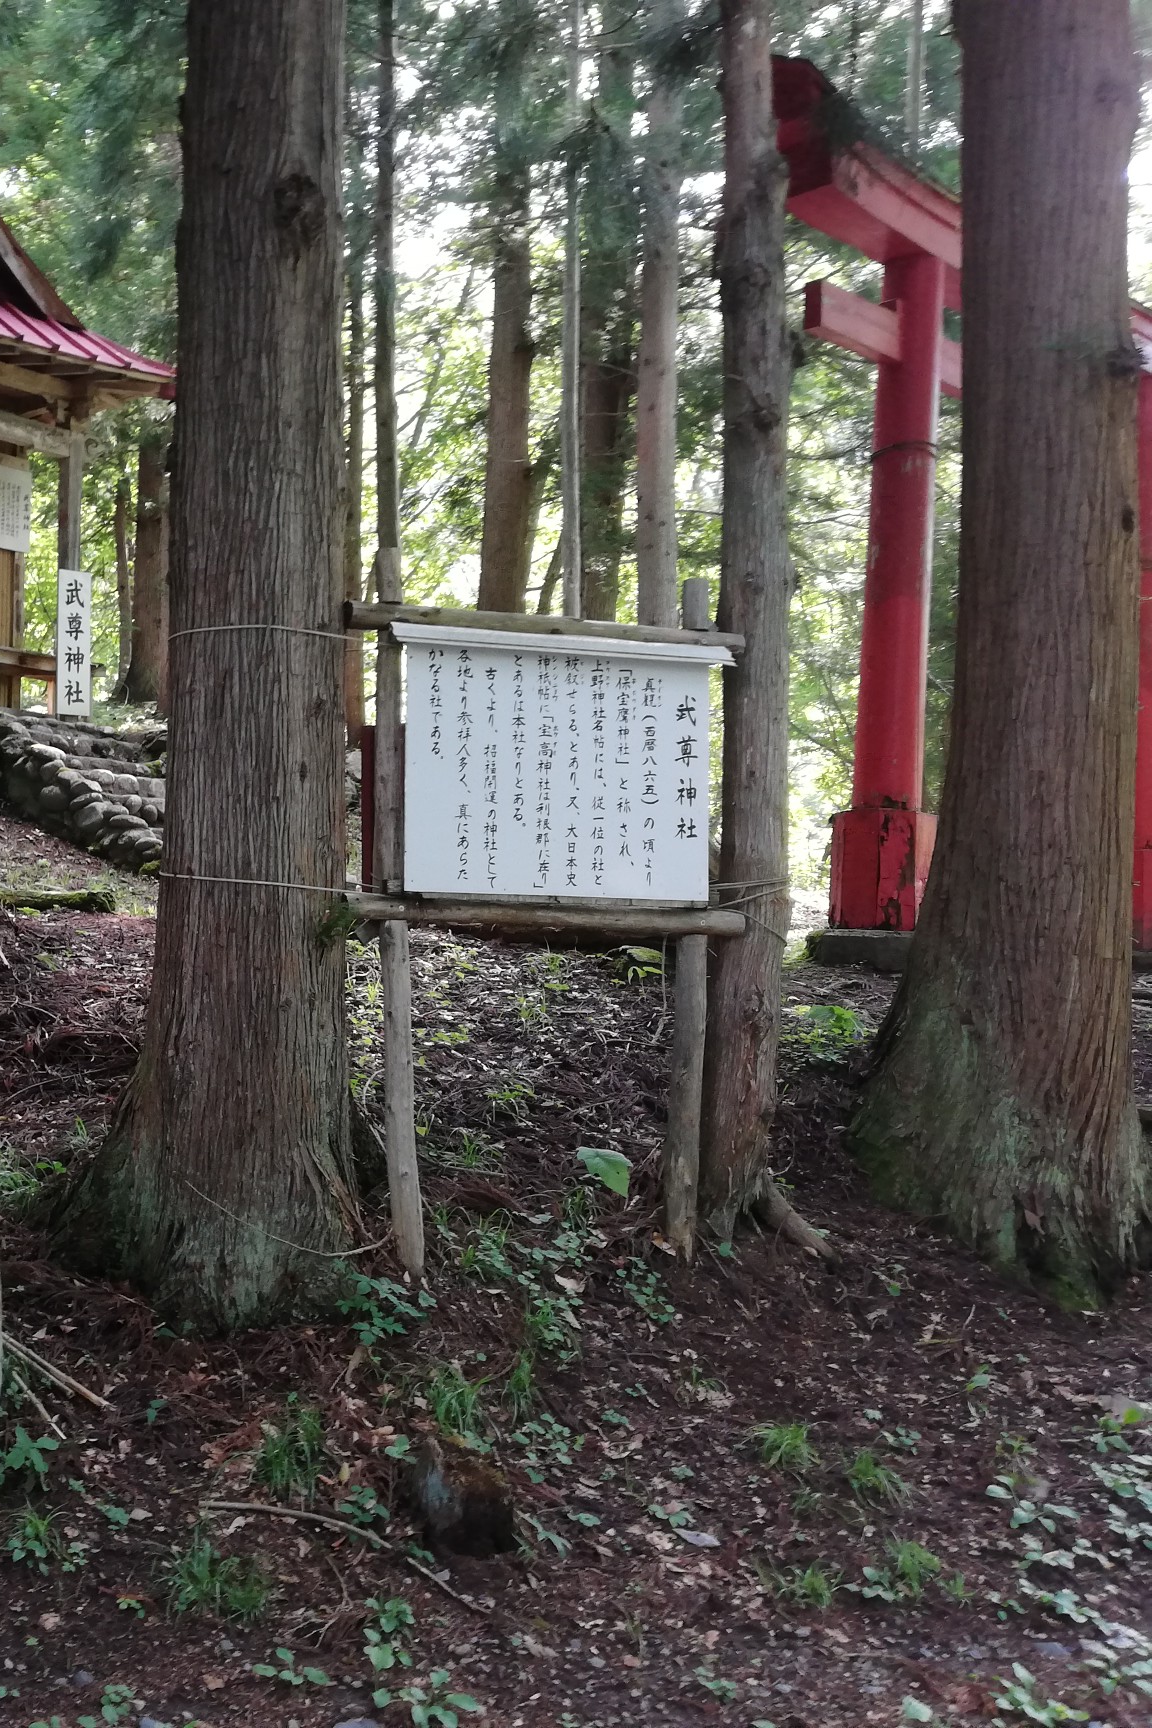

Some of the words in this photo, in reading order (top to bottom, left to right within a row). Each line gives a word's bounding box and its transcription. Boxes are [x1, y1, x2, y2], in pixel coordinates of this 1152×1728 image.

[64, 579, 85, 706] 武尊神社
[428, 648, 444, 760] かなる社である。
[675, 695, 699, 840] 武尊神社
